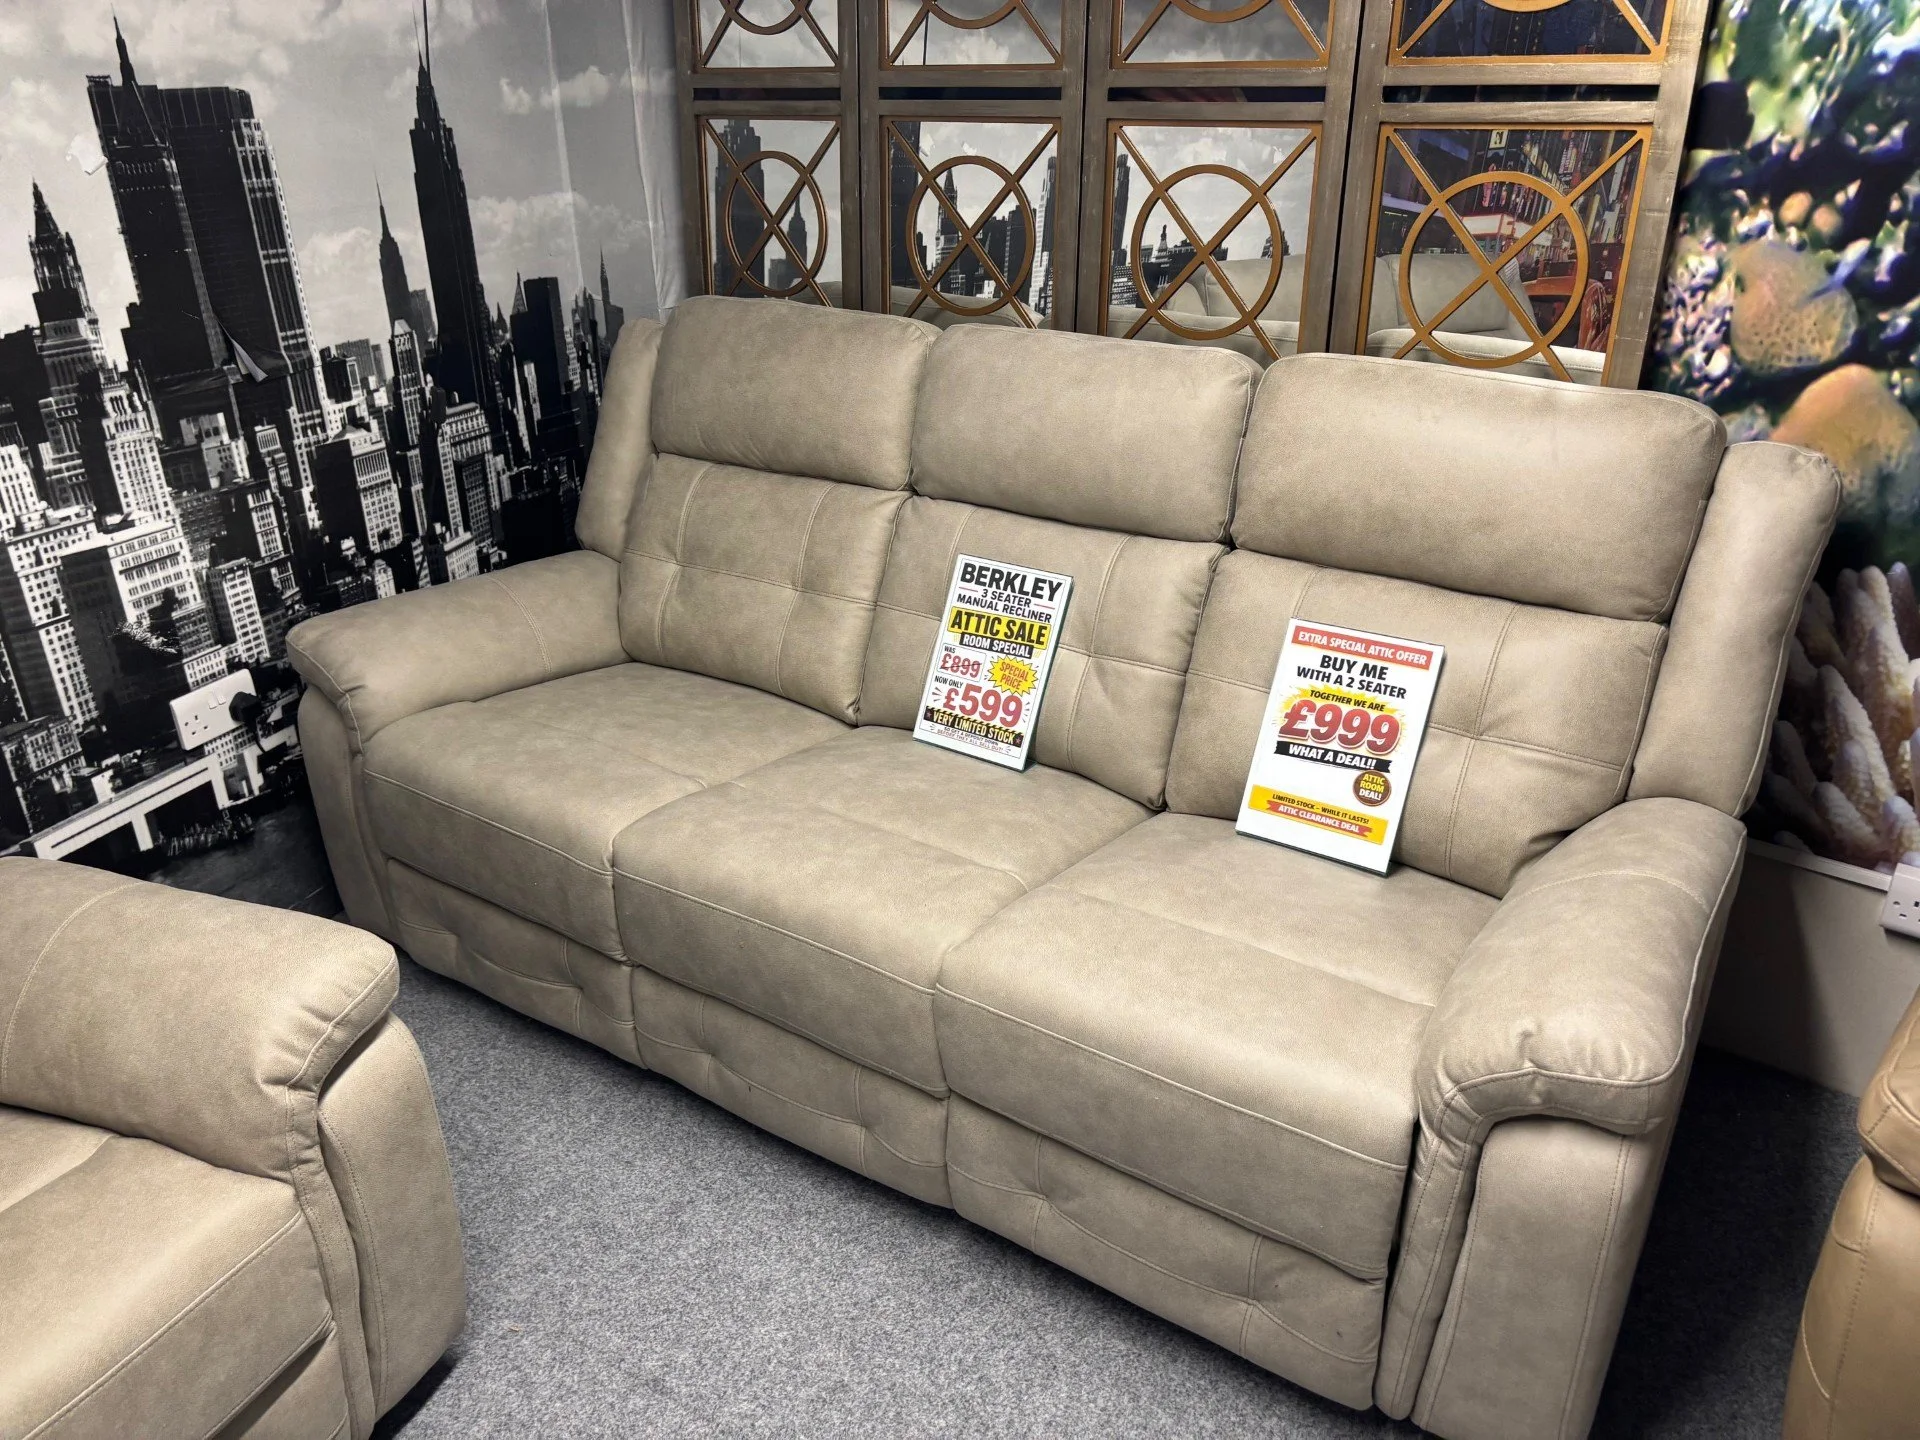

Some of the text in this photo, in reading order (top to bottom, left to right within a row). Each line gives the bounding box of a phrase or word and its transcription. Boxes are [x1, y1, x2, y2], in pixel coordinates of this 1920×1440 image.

[960, 563, 1062, 601] BERKLEY
[957, 594, 1051, 623] MANUAL RECLINER
[982, 589, 1031, 607] 3 SEATER
[951, 610, 1047, 645] ATTIC SALE
[963, 635, 1030, 657] ROOM SPECIAL
[1298, 631, 1427, 665] EXTRA SPECIAL ATTIC OFFER
[941, 653, 980, 678] £899
[1000, 662, 1029, 681] SPECIAL
[1320, 655, 1388, 680] BUY ME
[935, 676, 963, 688] NOW ONLY
[1000, 674, 1022, 689] PRICE
[1297, 666, 1407, 699] WITH A 2 SEATER
[943, 683, 1022, 727] £599
[1310, 690, 1385, 711] TOGETHER WE ARE
[933, 711, 1016, 745] VERY LIMITED STOCK
[1279, 699, 1400, 754] £999
[1289, 744, 1376, 769] WHAT A DEAL!!
[1360, 781, 1384, 793] ROOM
[1363, 773, 1385, 785] ATTIC
[1359, 789, 1382, 800] DEAL!
[1273, 794, 1296, 804] LIMITED
[1296, 800, 1315, 810] STOCK
[1321, 806, 1340, 817] WHILE
[1349, 814, 1369, 824] LASTS!
[1279, 805, 1359, 833] ATTIC CLEARANCE DEAL
